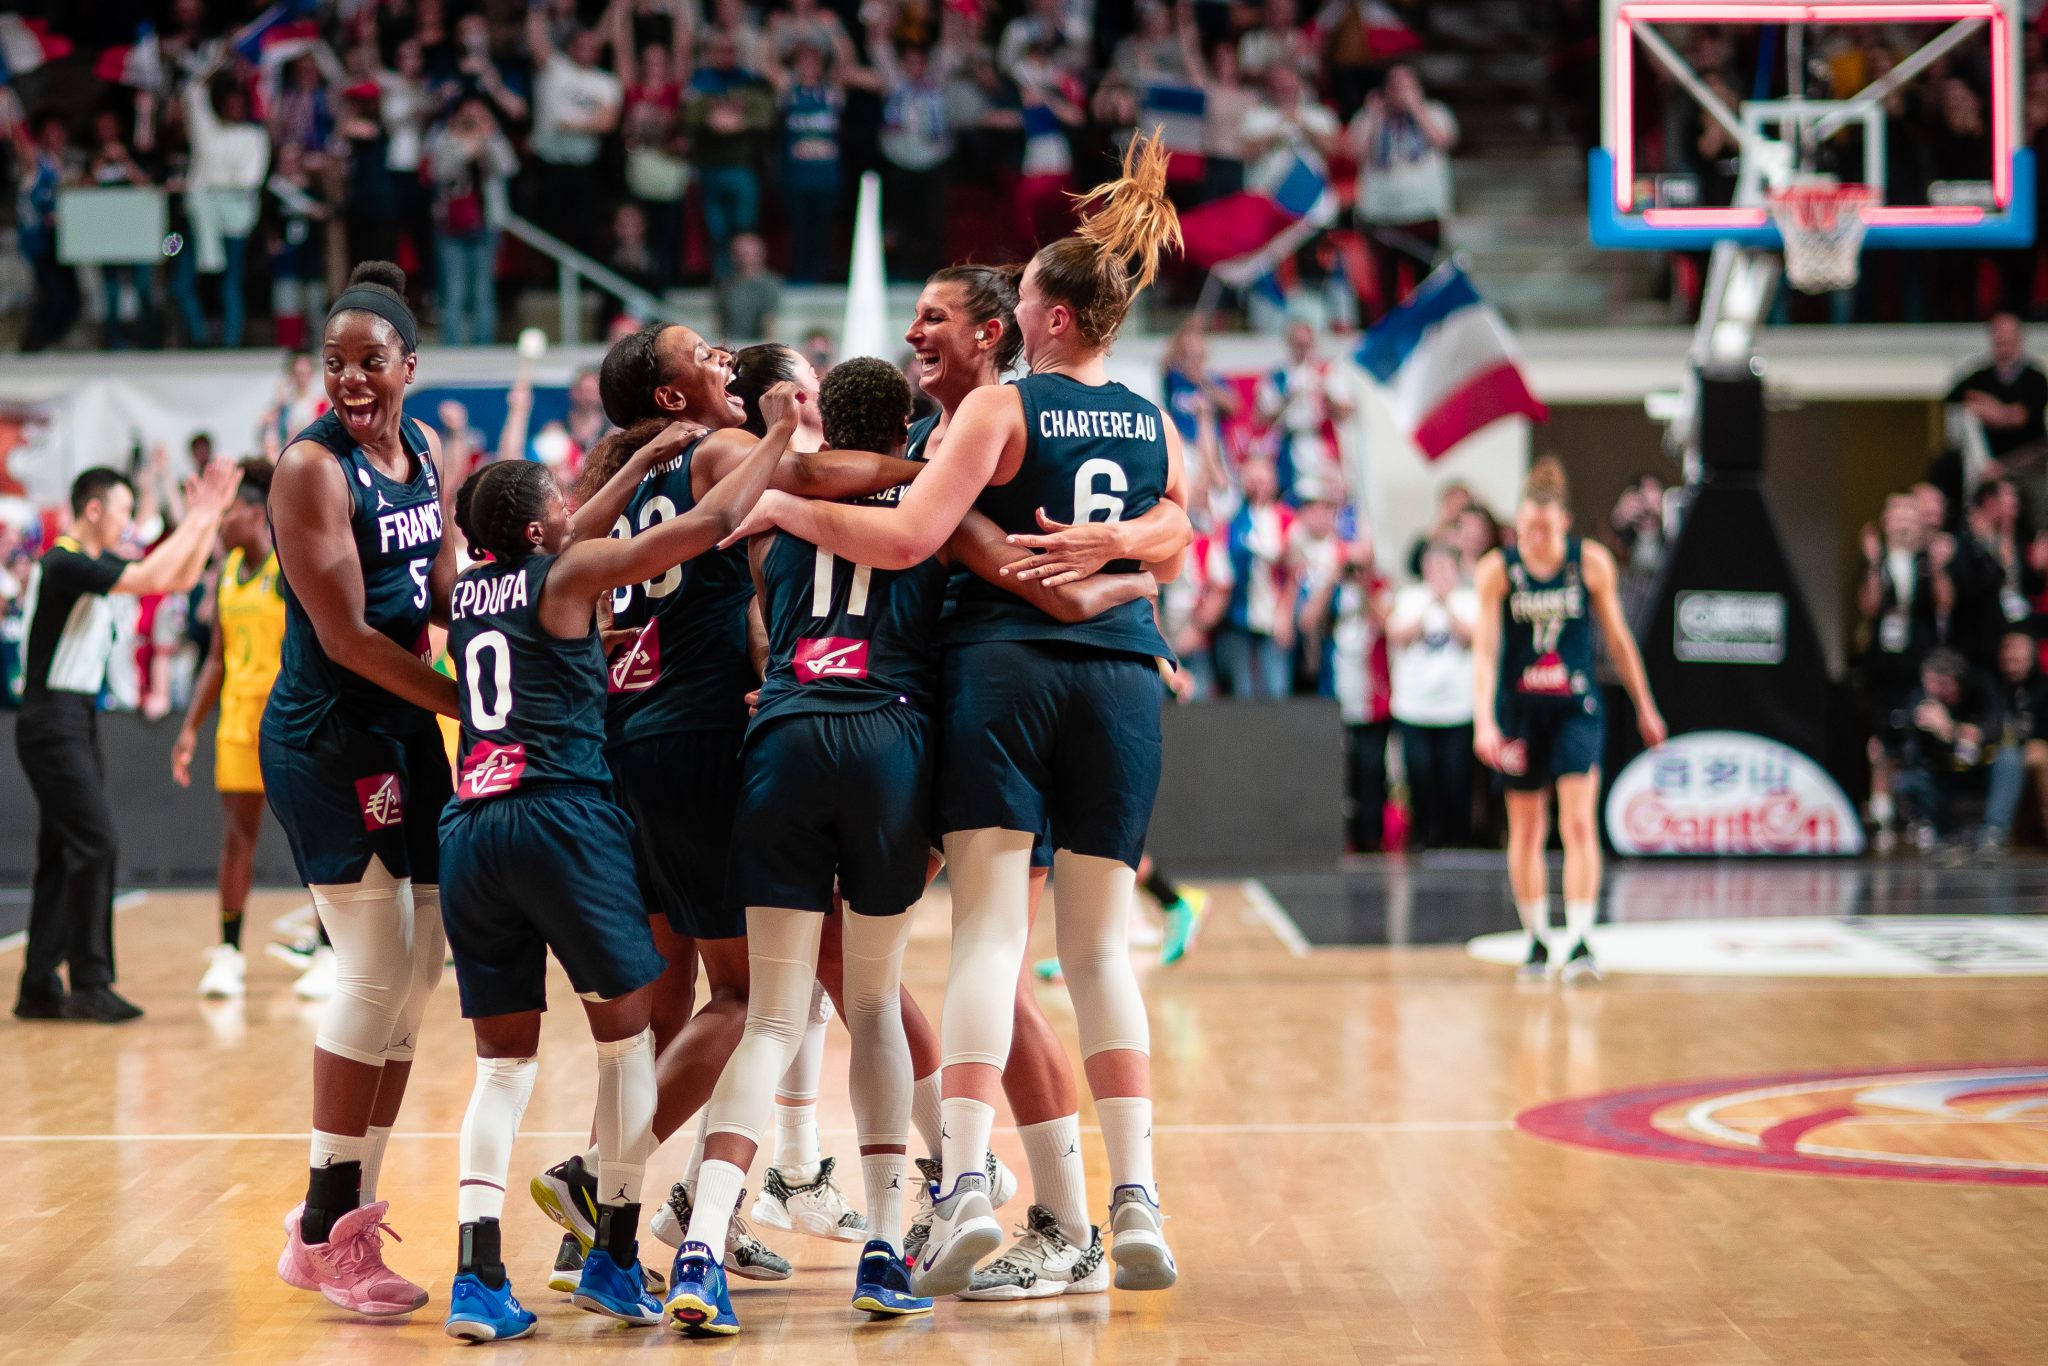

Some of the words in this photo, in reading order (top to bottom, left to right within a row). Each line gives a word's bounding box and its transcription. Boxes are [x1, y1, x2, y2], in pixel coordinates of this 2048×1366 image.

[1040, 409, 1157, 442] CHARTEREAU
[1072, 458, 1128, 526] 6
[409, 557, 428, 609] 5
[451, 569, 528, 621] EPOUPA
[465, 630, 513, 731] 0
